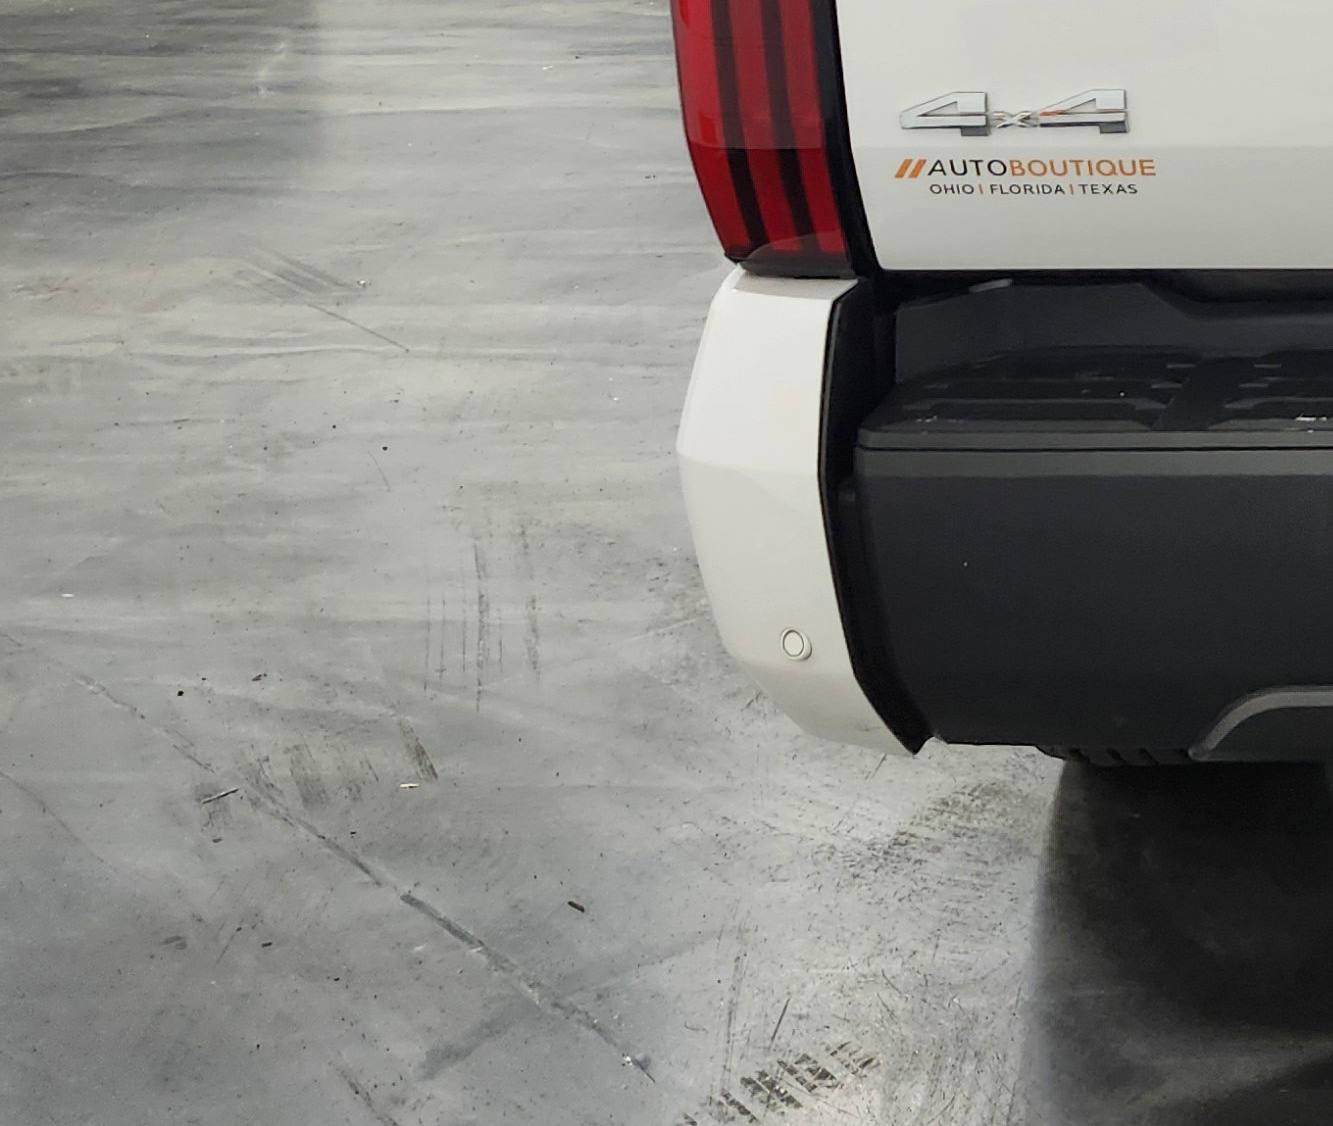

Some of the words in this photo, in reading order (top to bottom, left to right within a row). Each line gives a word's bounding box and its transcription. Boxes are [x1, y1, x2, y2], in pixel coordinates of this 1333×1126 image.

[929, 183, 975, 195] OHIO
[989, 183, 1065, 195] FLORIDA
[1079, 183, 1138, 195] TEXAS
